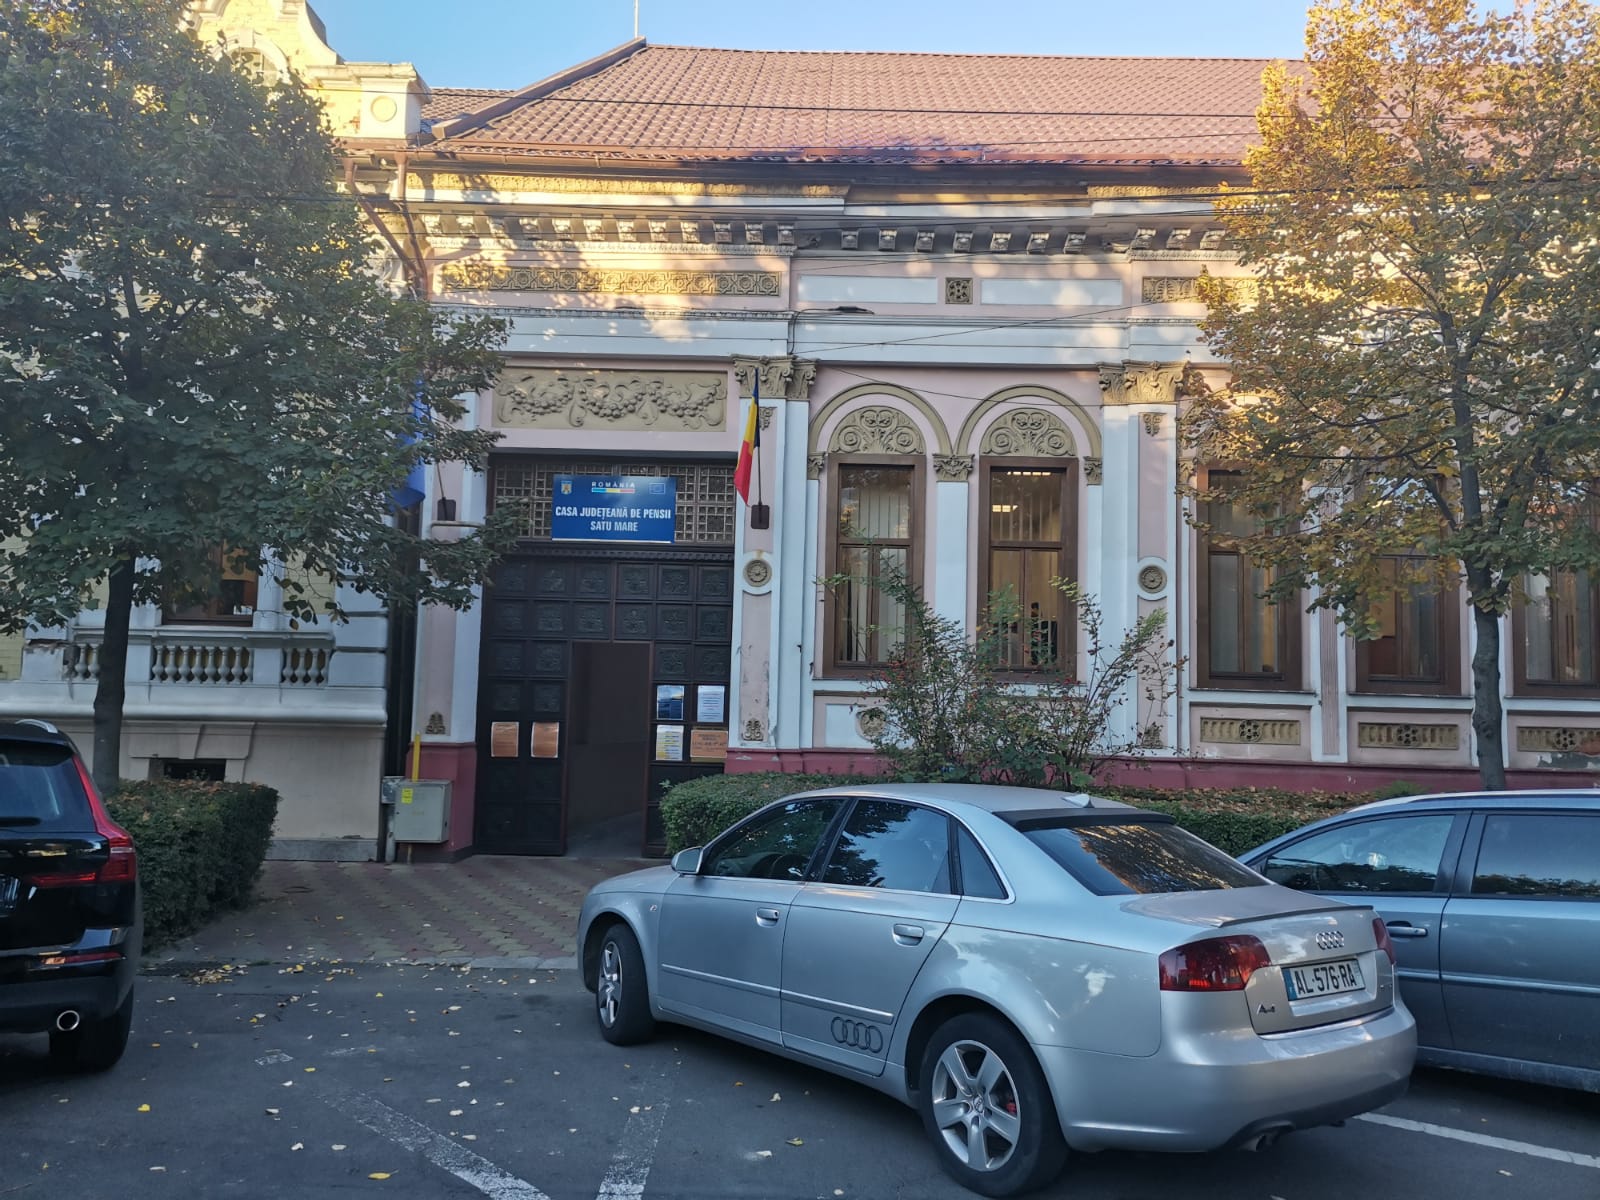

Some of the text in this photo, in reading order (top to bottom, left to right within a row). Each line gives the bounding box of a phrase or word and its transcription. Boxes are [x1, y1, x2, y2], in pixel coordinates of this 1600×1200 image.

[555, 505, 578, 517] CASA
[630, 508, 641, 519] DE
[643, 508, 672, 519] PENSII
[590, 521, 639, 532] SATU MARE
